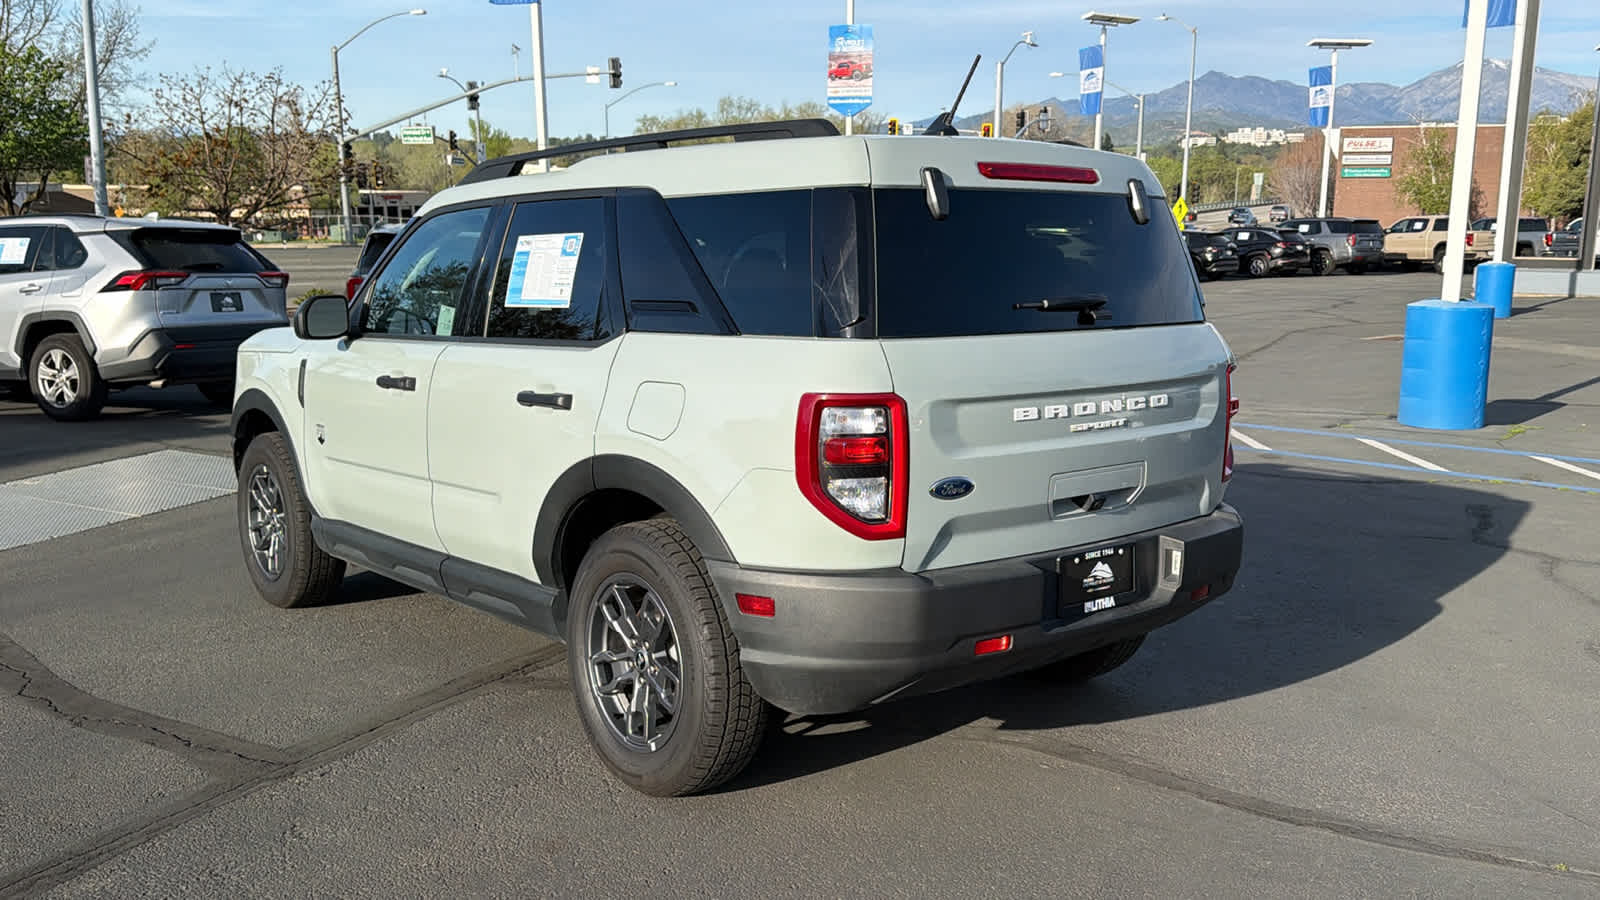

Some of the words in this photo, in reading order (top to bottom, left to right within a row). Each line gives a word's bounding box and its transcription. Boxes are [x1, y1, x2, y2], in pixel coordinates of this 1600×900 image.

[1346, 140, 1377, 148] PULSE
[1013, 394, 1168, 421] BRONCO
[1070, 418, 1128, 433] SPORT
[1085, 550, 1101, 560] SINCE
[1091, 595, 1116, 612] LITHIA
